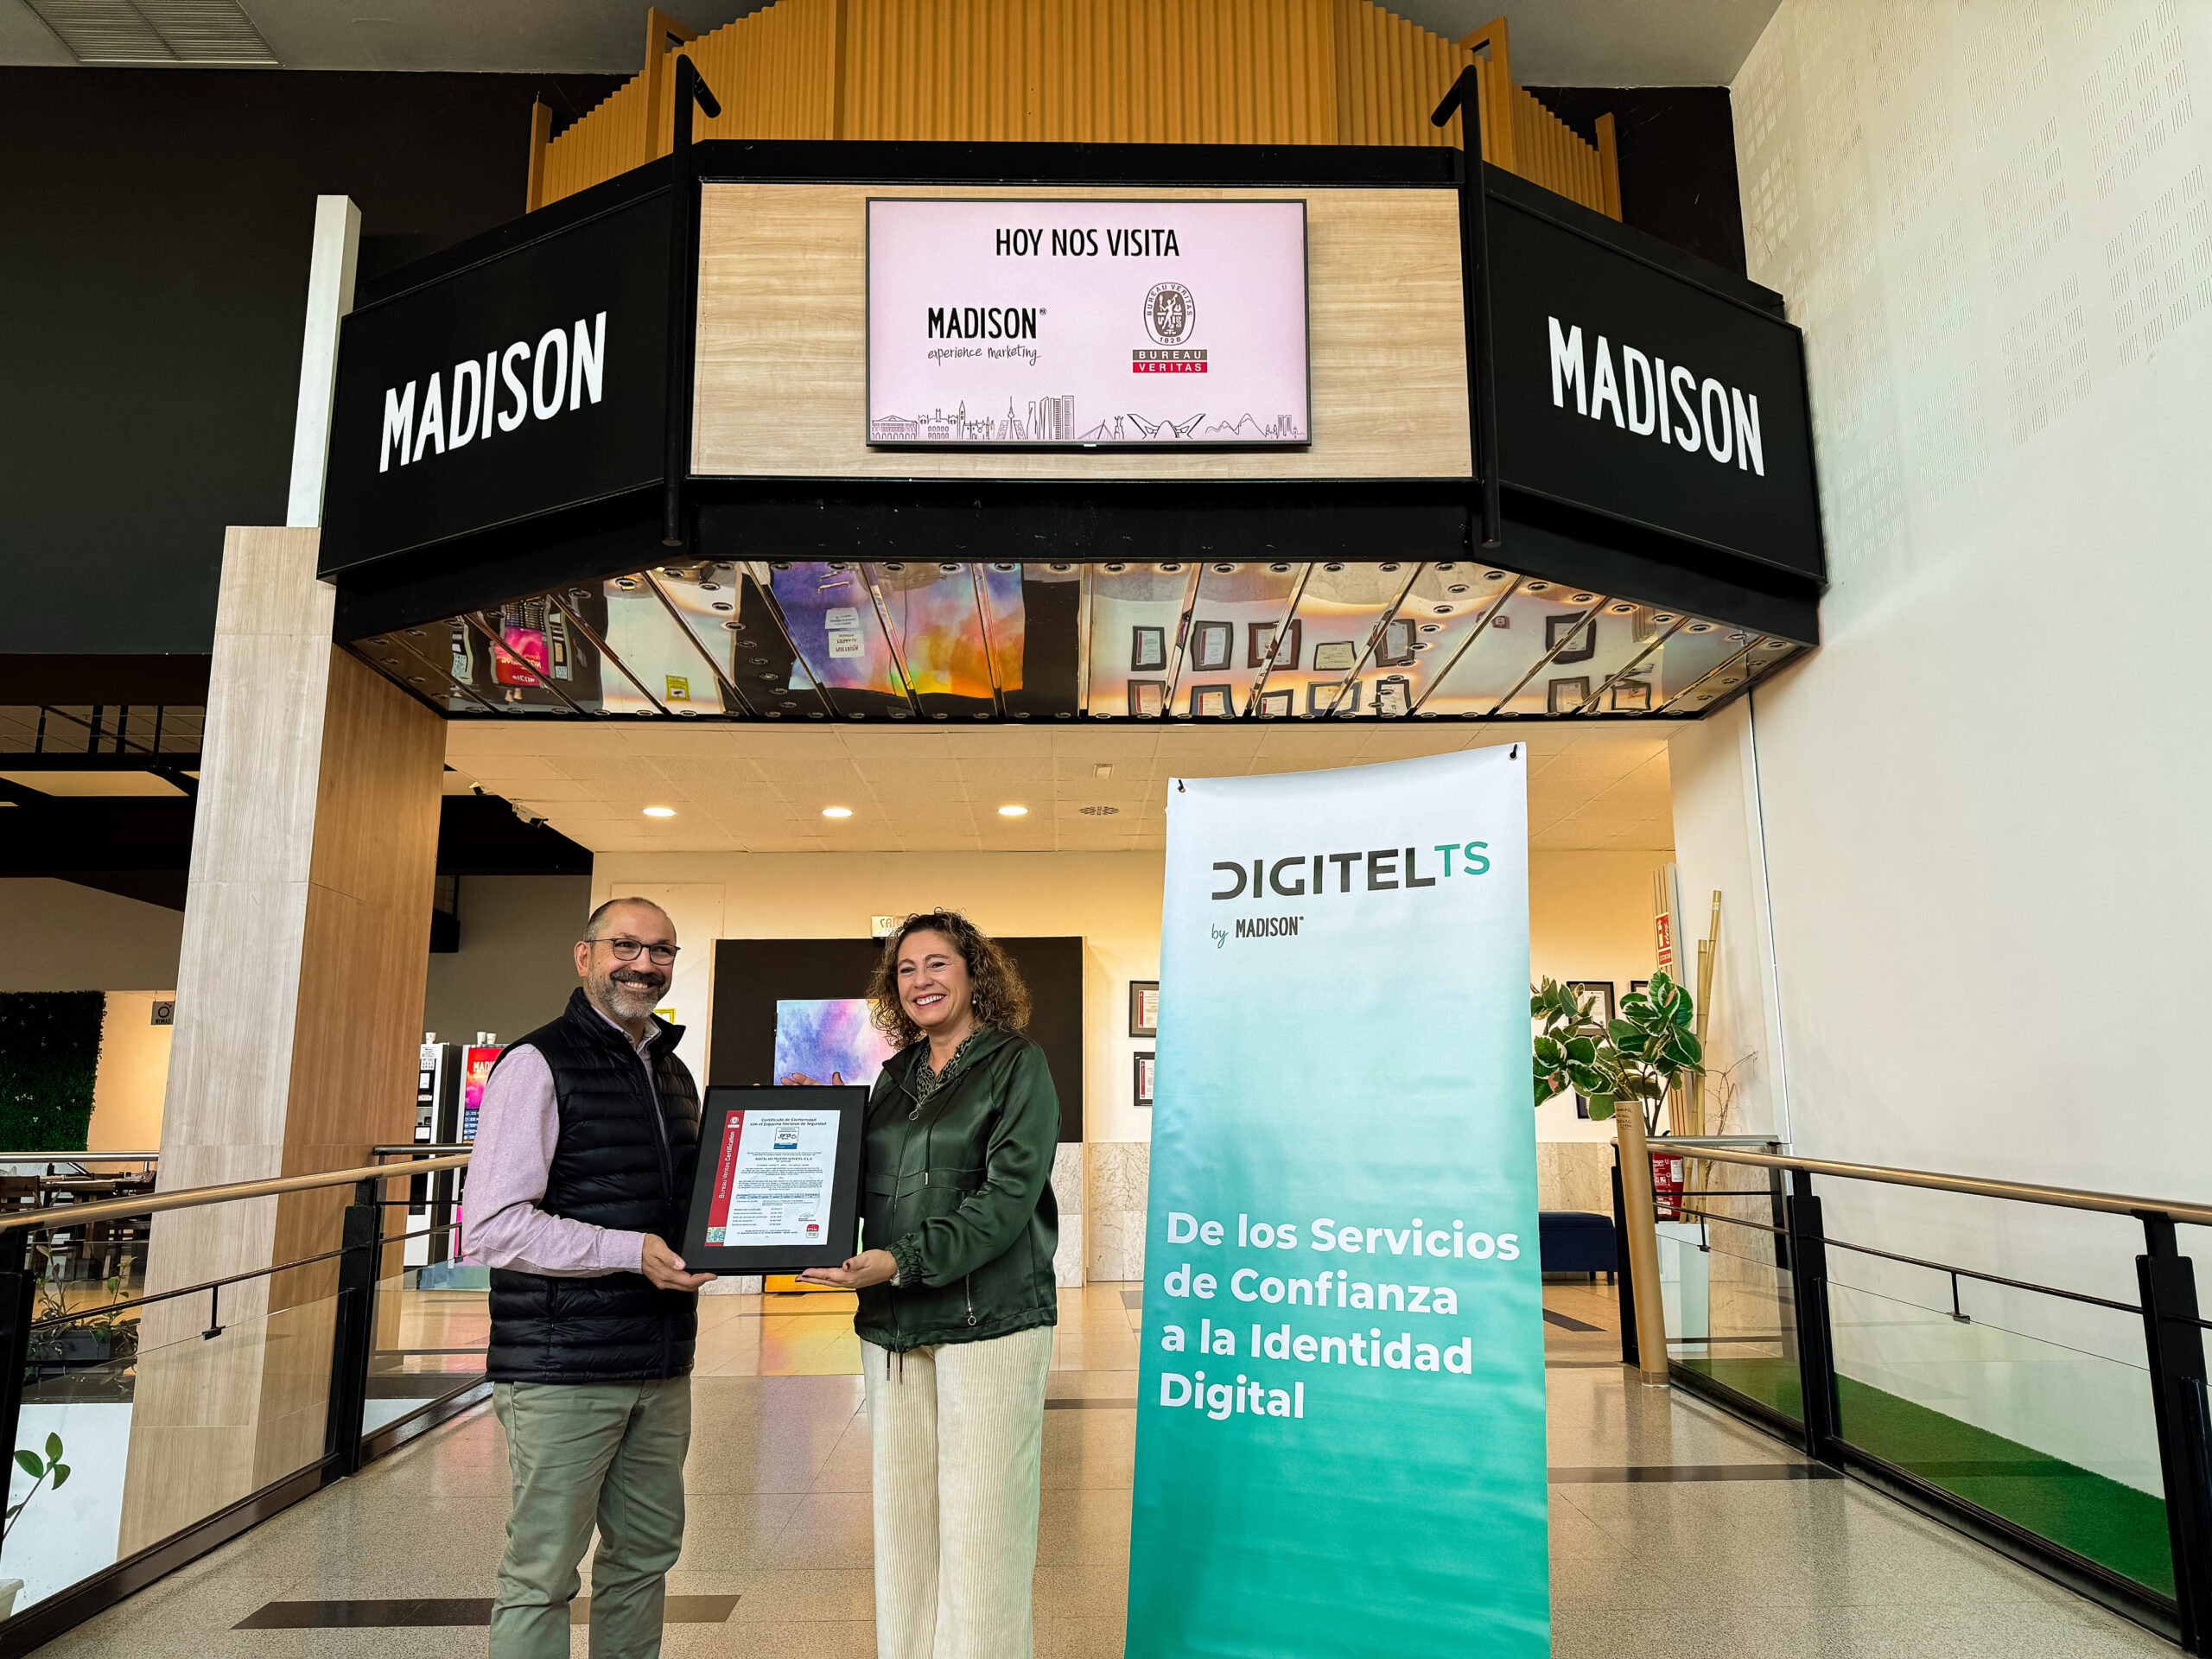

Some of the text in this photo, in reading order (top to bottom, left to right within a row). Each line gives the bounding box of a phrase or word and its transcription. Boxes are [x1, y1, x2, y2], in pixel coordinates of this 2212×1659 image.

[996, 228, 1179, 257] HOY NOS VISITA
[1147, 284, 1192, 316] BUREAU VERITAS
[928, 307, 1037, 339] MADISON
[927, 344, 1041, 366] experience marketing
[1139, 351, 1201, 359] BUREAU
[1139, 363, 1202, 372] VERITAS
[379, 311, 607, 474] MADISON
[1548, 315, 1764, 476] MADISON
[1211, 916, 1299, 949] by MADISON
[719, 1179, 728, 1198] Bureau
[725, 1131, 735, 1161] Certification
[1167, 1211, 1521, 1262] De los Servicios
[1164, 1263, 1458, 1315] de Confianza
[1160, 1318, 1472, 1374] a la Identidad
[1160, 1370, 1304, 1421] Digital
